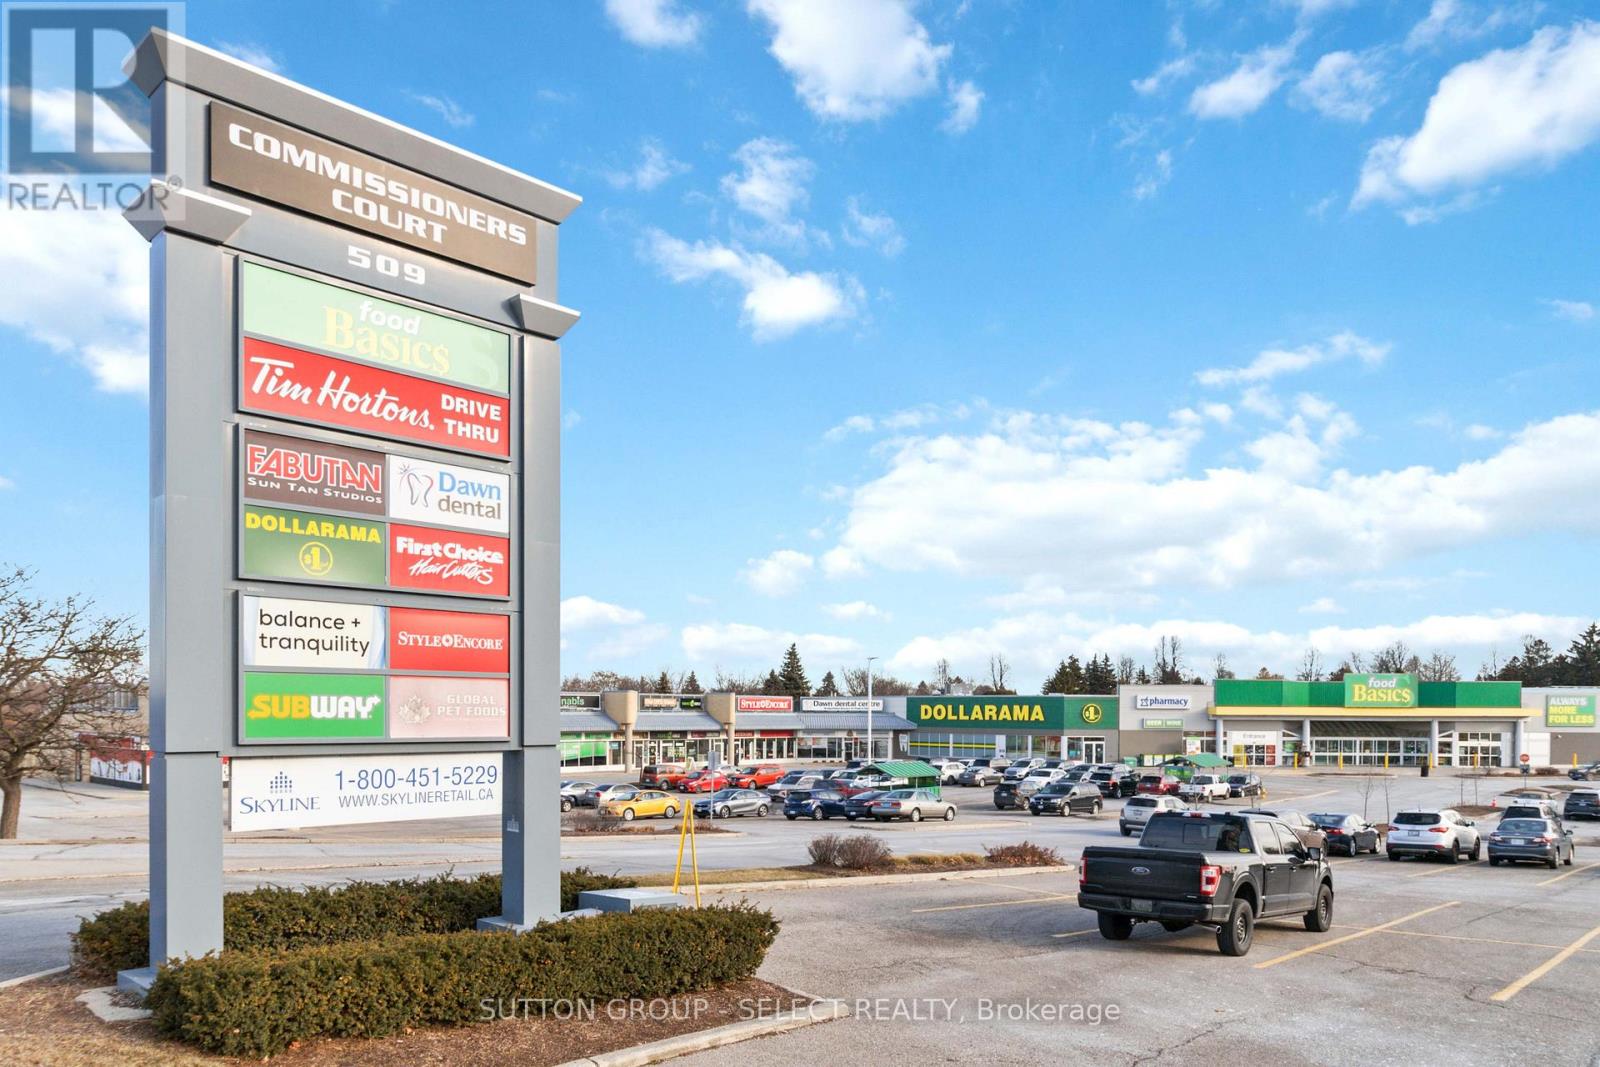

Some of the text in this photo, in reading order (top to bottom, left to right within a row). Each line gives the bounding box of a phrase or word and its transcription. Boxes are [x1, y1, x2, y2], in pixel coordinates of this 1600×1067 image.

[228, 122, 527, 246] COMMISSIONERS
[331, 188, 448, 244] COURT
[347, 245, 426, 286] 509
[359, 300, 422, 335] food
[250, 356, 312, 405] Tim
[441, 394, 502, 421] DRIVE
[443, 418, 499, 443] THRU
[247, 444, 382, 494] FABUTAN
[247, 477, 383, 504] SUN TAN STUDIOS
[438, 471, 501, 501] Dawn
[438, 497, 501, 520] dental
[245, 513, 381, 544] DOLLARAMA
[396, 536, 504, 565] First Choice
[408, 557, 493, 585] Hair Cutters
[259, 609, 345, 630] balance
[259, 632, 370, 657] tranquility
[1368, 677, 1397, 688] food
[248, 694, 381, 720] SUBWAY
[437, 706, 506, 717] PET FOODS
[447, 694, 497, 705] GLOBAL
[813, 700, 833, 708] Dawn
[835, 700, 857, 708] dental
[1149, 697, 1188, 707] pharmacy
[1549, 706, 1577, 714] MORE
[1550, 697, 1587, 705] ALWAYS
[920, 704, 1045, 721] DOLLARAMA
[1549, 715, 1594, 724] FOR LESS
[335, 765, 498, 791] 1-800-451-5229
[239, 796, 320, 815] SKYLINE
[338, 788, 494, 808] WWW.SKYLINERETAIL.CA
